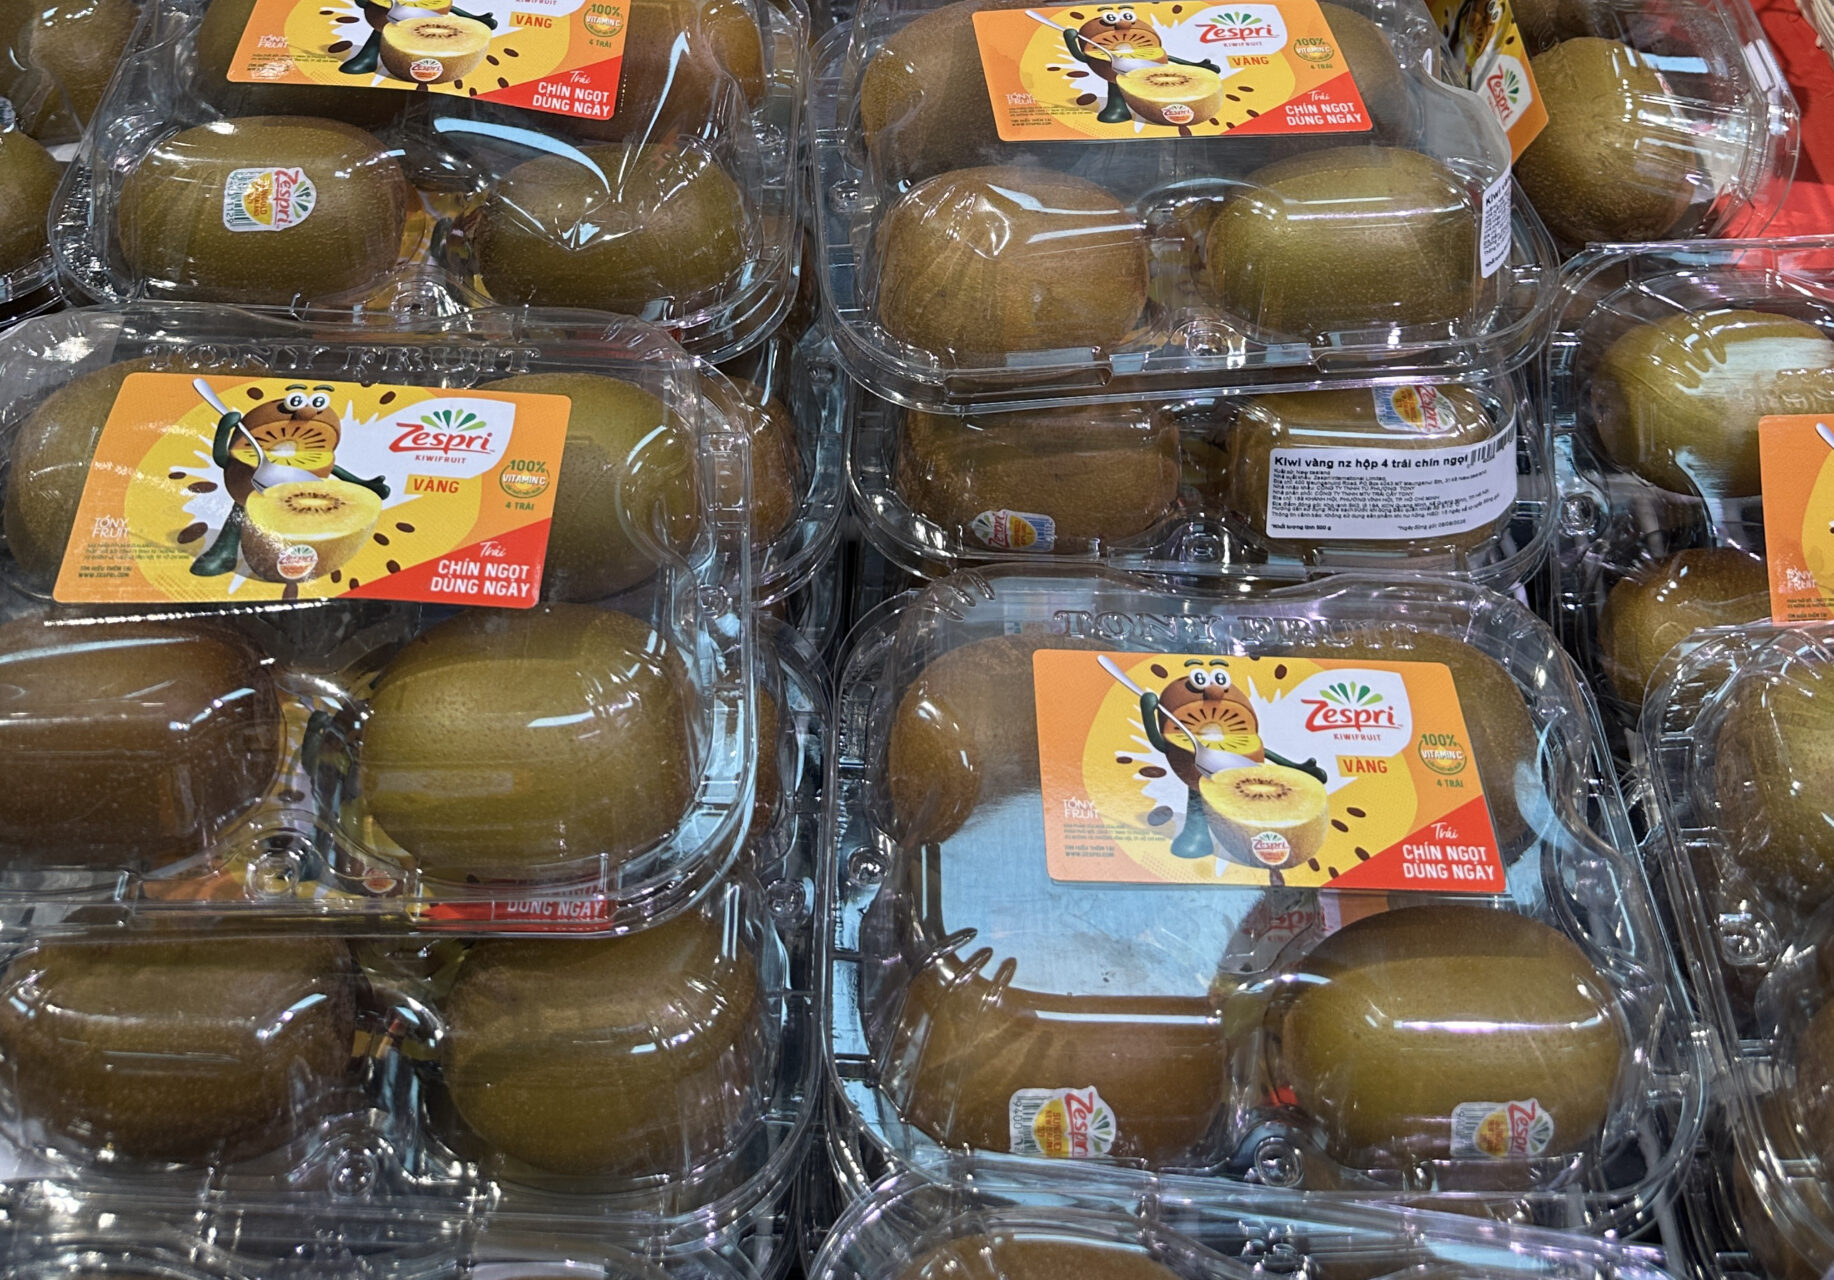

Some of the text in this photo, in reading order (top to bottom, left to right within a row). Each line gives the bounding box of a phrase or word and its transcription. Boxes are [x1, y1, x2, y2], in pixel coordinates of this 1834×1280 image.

[590, 3, 621, 15] 100%
[515, 13, 553, 29] VÀNG
[1194, 23, 1280, 44] Zespri
[1296, 37, 1326, 46] 100%
[1232, 55, 1270, 66] VÀNG
[538, 81, 610, 105] CHÍN NGỌT
[532, 93, 610, 117] DÙNG NGAY
[1285, 101, 1355, 116] CHÍN NGỌT
[1286, 113, 1363, 127] DÙNG NGAY
[273, 170, 299, 229] Zespri
[145, 343, 541, 374] TONY FRUIT
[388, 421, 496, 455] Zespri
[414, 454, 467, 464] KIWIFRUIT
[509, 459, 547, 473] 100%
[1274, 457, 1302, 467] Kiwi
[1305, 458, 1334, 469] vàng
[1355, 458, 1379, 470] hộp
[1381, 459, 1388, 468] 4
[1391, 458, 1412, 468] trái
[1415, 457, 1440, 468] chín
[413, 477, 460, 494] VÀNG
[502, 473, 546, 486] VITAMIN C
[91, 527, 131, 539] FRUIT
[479, 540, 507, 558] Trái
[438, 558, 530, 582] CHÍN NGỌT
[431, 575, 531, 598] DÙNG NGAY
[1053, 610, 1418, 650] TONY FRUIT
[1300, 698, 1404, 732] Zespri
[1333, 733, 1382, 742] KIWIFRUIT
[1421, 733, 1458, 747] 100%
[1420, 749, 1455, 760] VITAMIN
[1343, 757, 1388, 774] VÀNG
[1445, 779, 1464, 788] TRÁI
[1064, 809, 1100, 819] FRUIT
[1431, 821, 1459, 839] Trái
[1402, 842, 1486, 864] CHÍN NGỌT
[1403, 860, 1494, 880] DÙNG NGAY
